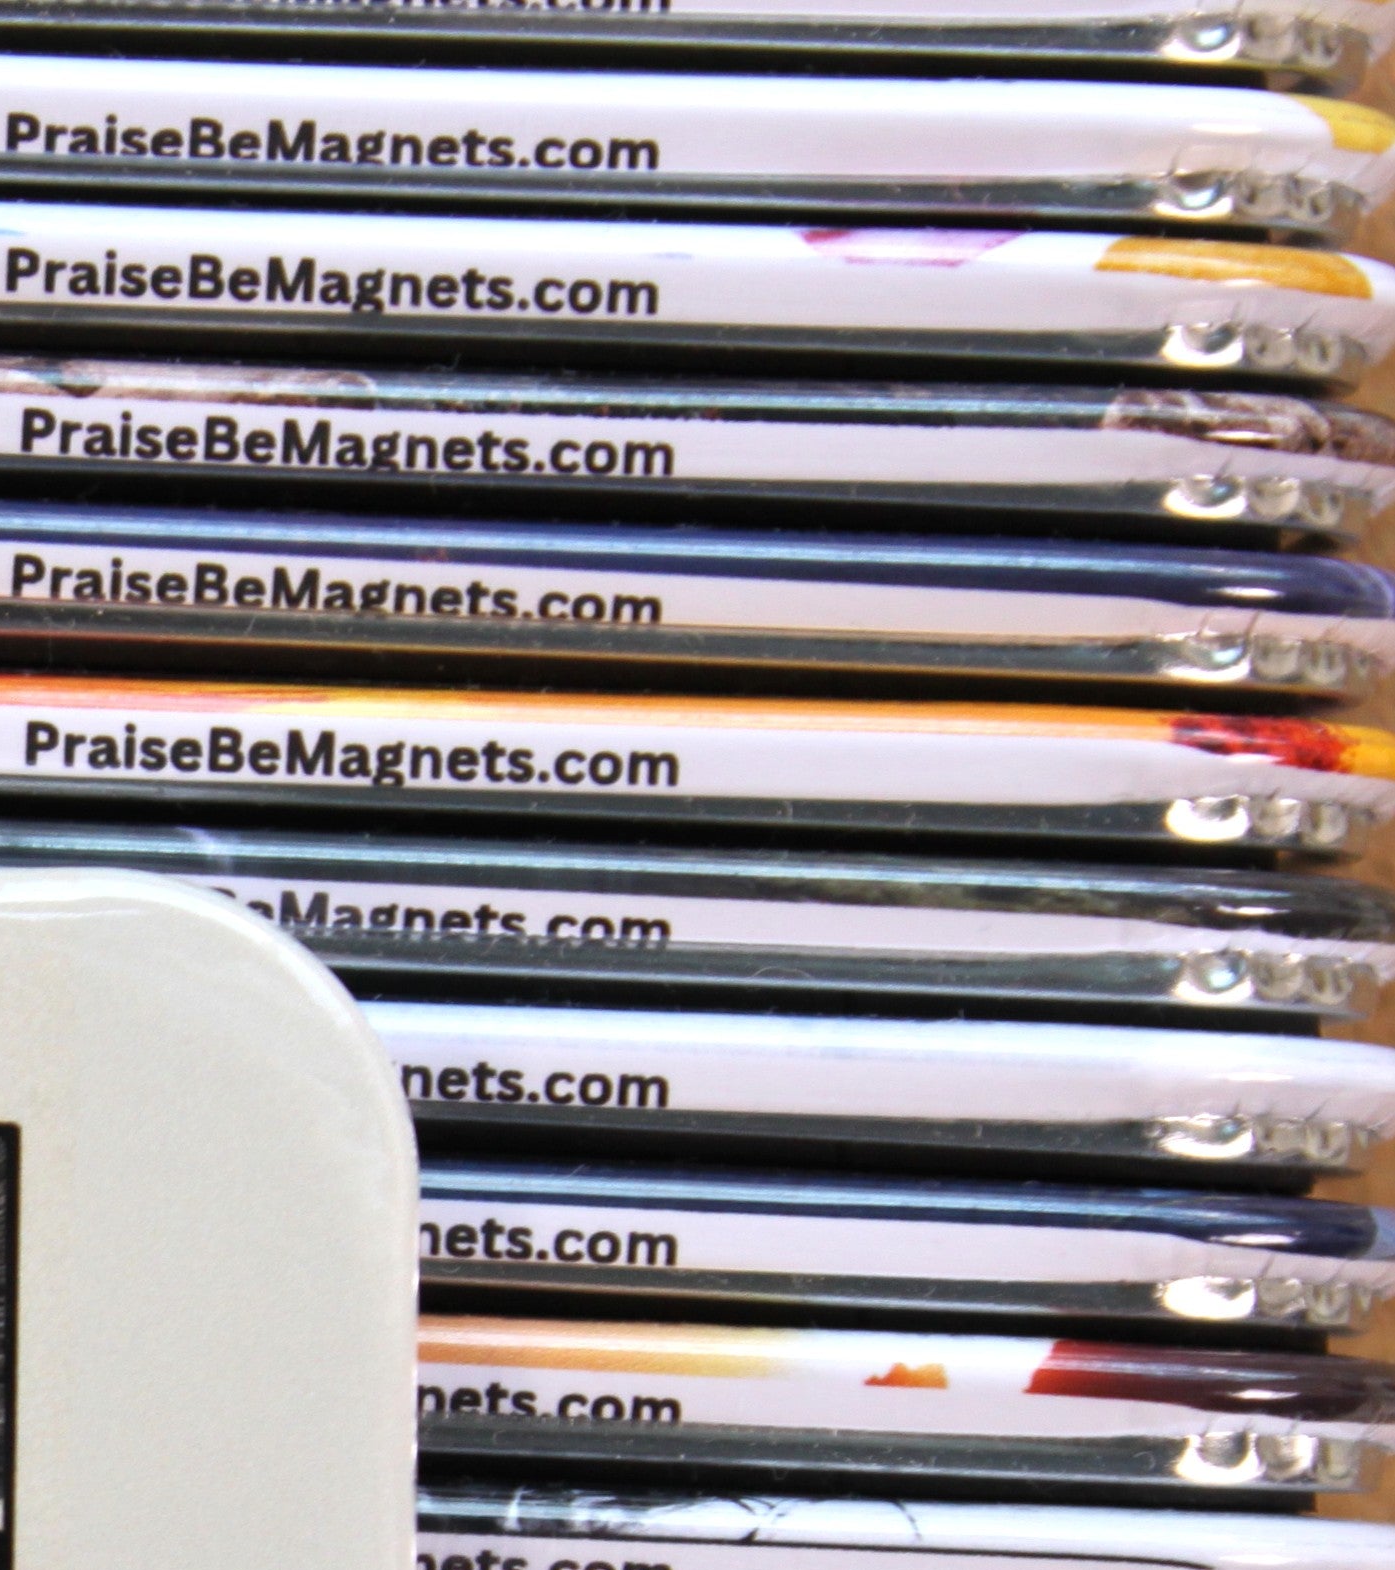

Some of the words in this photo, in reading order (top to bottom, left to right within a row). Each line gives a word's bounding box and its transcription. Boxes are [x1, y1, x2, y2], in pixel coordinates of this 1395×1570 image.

[6, 113, 660, 170] PraiseBeMagnets.com
[5, 248, 658, 314] PraiseBeMagnets.com
[21, 408, 674, 475] PraiseBeMagnets.com
[12, 555, 662, 623] PraiseBeMagnets.com
[25, 721, 680, 787] PraiseBeMagnets.com
